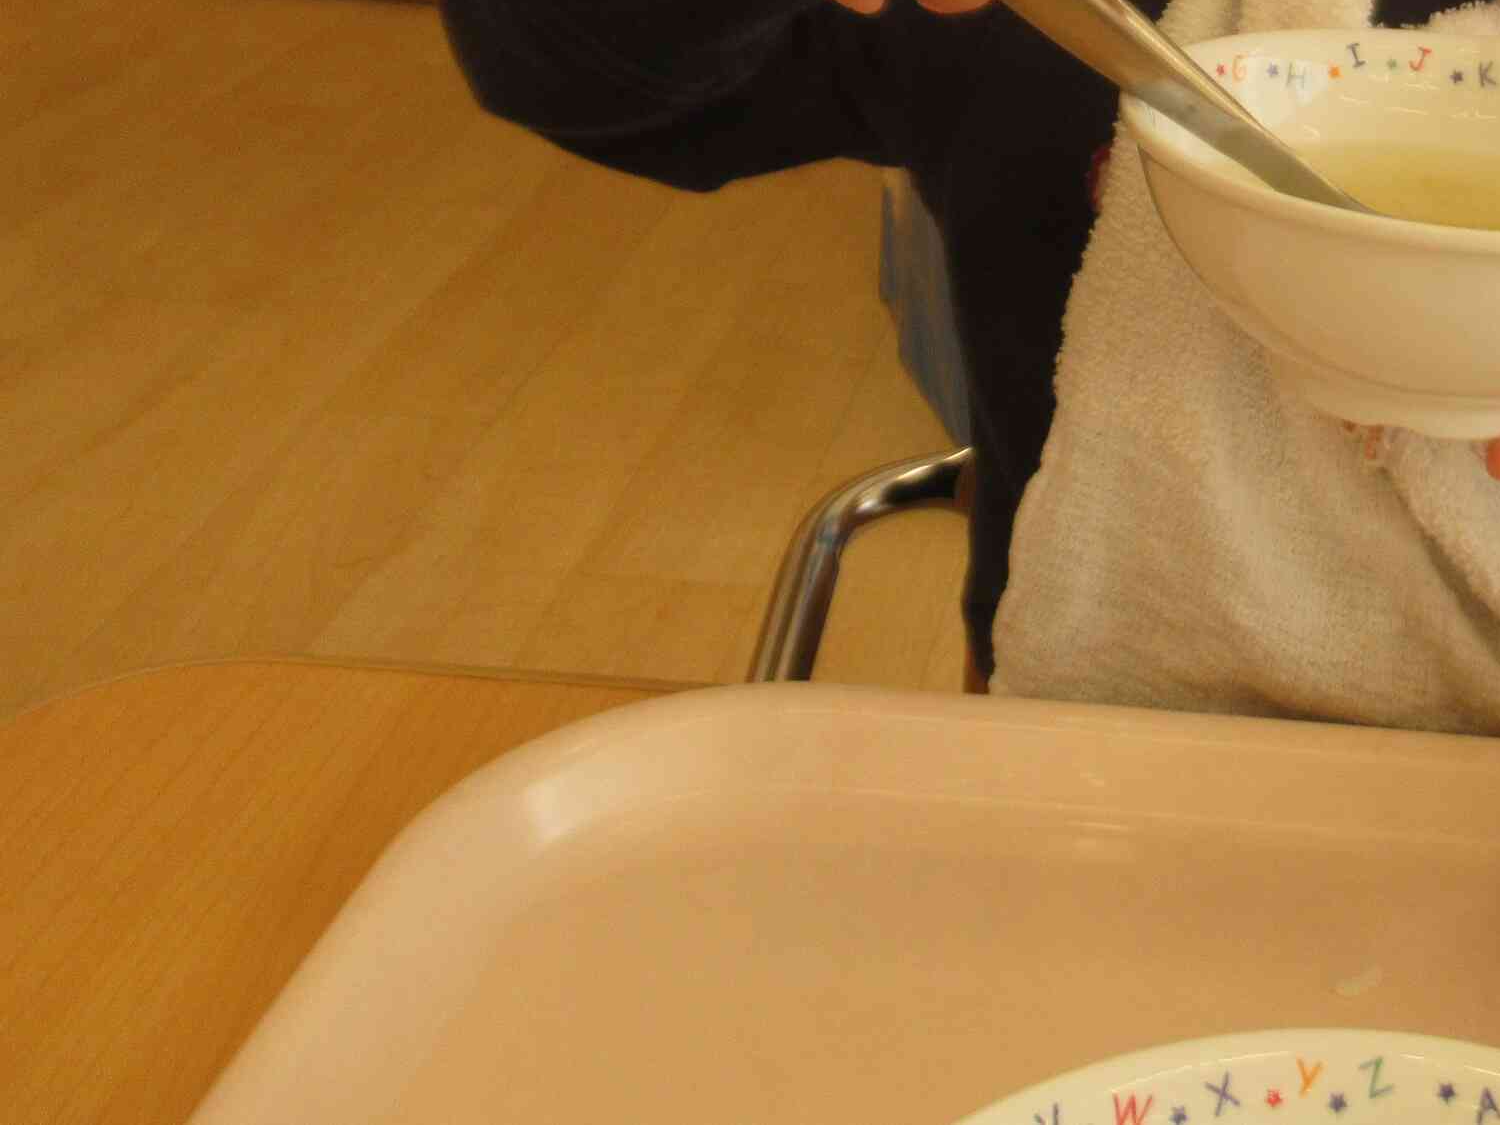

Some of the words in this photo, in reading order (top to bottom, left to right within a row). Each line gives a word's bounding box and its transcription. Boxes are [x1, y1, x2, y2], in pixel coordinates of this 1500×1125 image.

[1409, 46, 1432, 71] J
[1478, 60, 1497, 87] K
[1112, 1094, 1153, 1125] W
[1205, 1072, 1240, 1117] X
[1296, 1057, 1322, 1098] Y
[1358, 1056, 1395, 1099] Z
